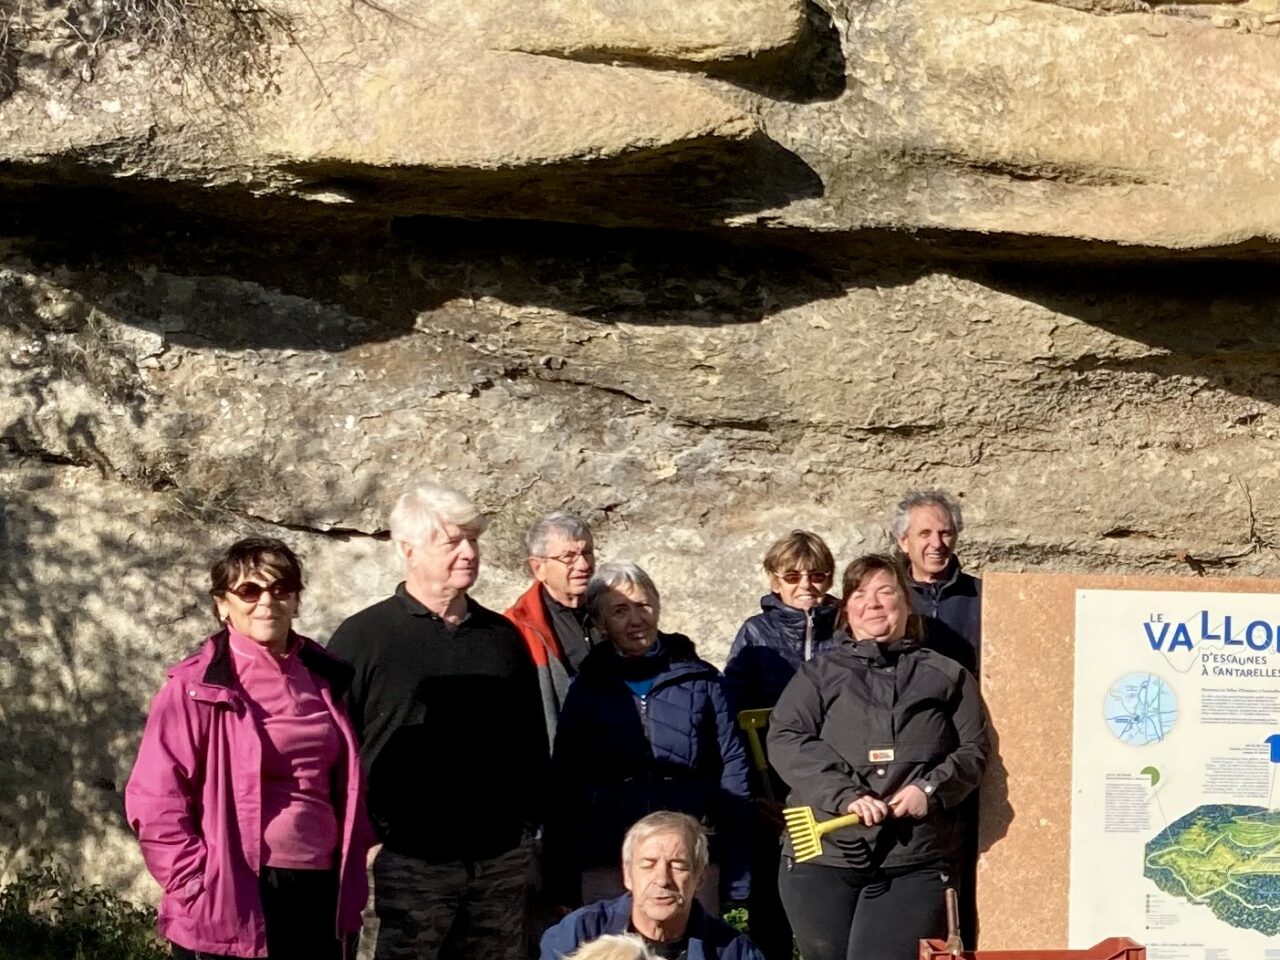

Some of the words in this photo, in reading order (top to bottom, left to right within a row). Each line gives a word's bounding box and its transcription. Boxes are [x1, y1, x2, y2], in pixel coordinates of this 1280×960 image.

[1150, 613, 1164, 623] LE
[1201, 652, 1267, 665] D'ESCAUNES
[1201, 665, 1209, 676] À
